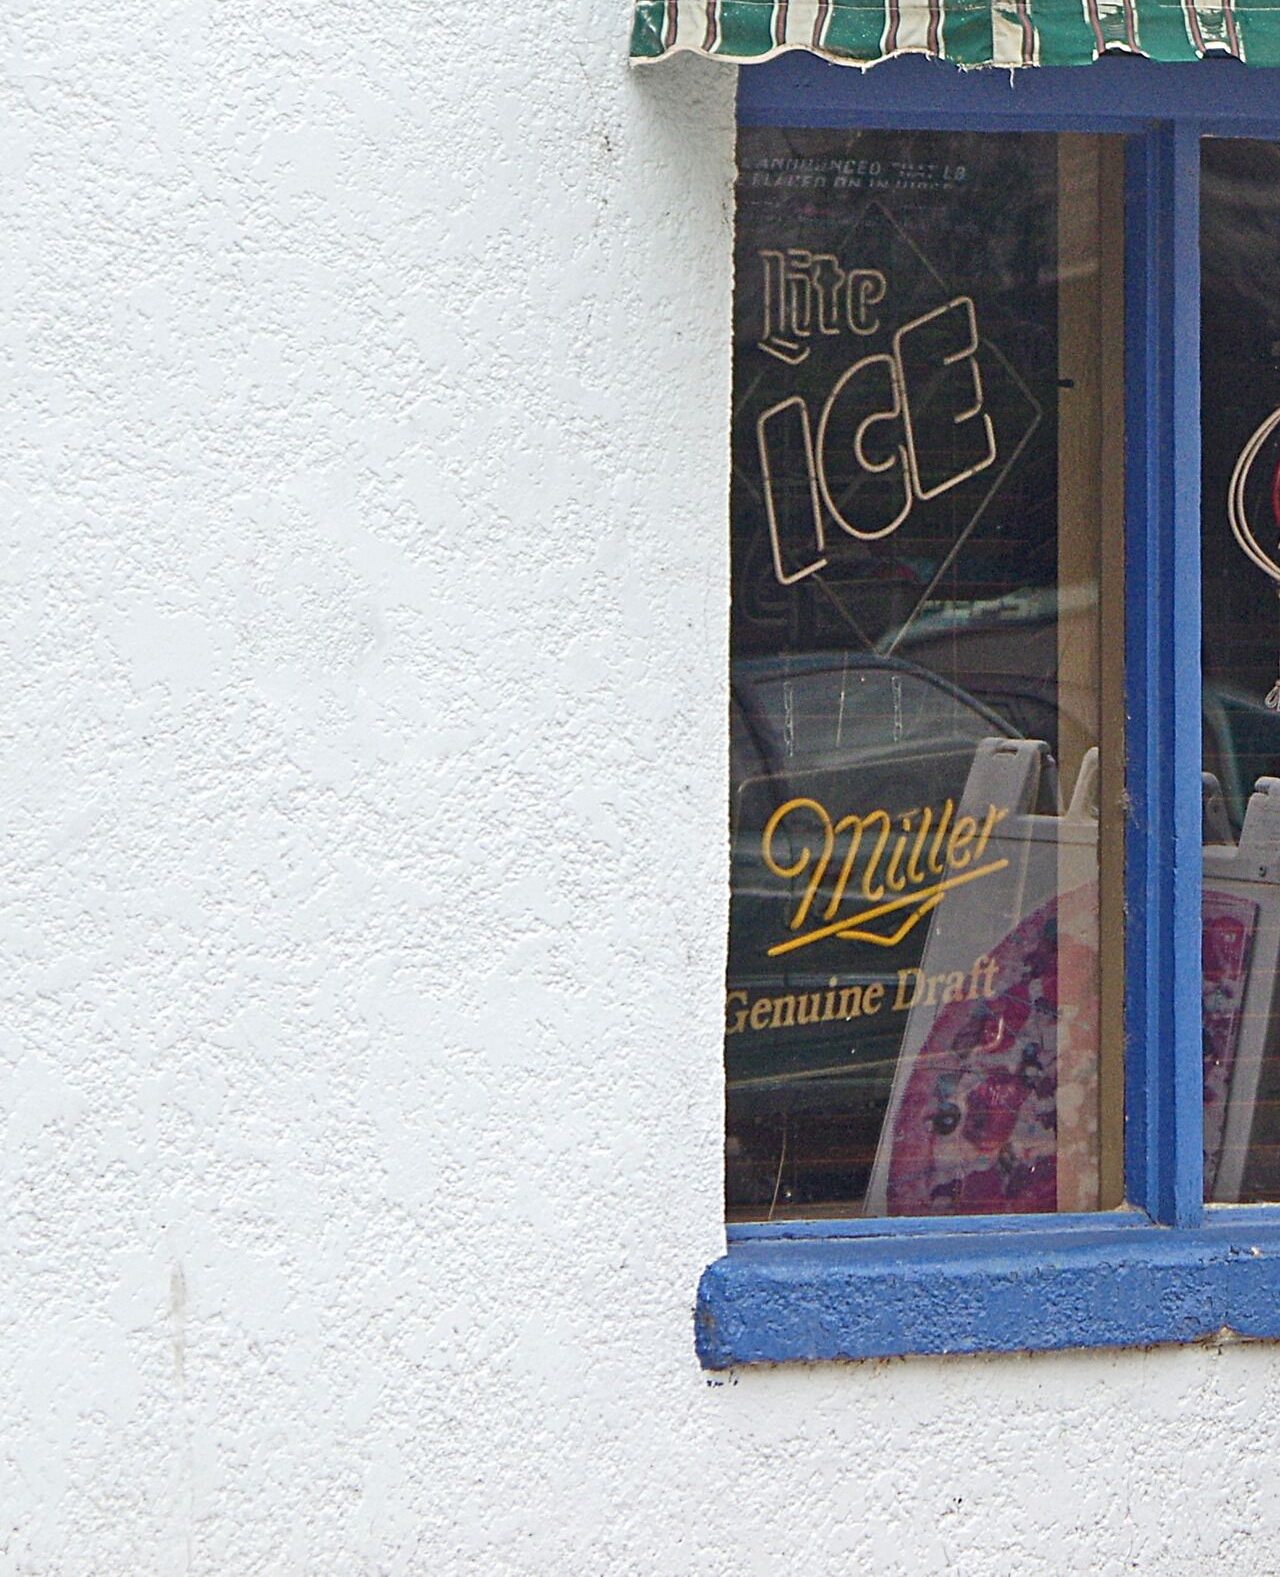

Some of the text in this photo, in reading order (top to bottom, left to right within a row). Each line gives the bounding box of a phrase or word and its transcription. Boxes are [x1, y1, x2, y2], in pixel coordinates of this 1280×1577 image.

[757, 296, 998, 586] ICE
[760, 798, 1008, 928] Miller
[725, 955, 999, 1034] Genuine Draft
